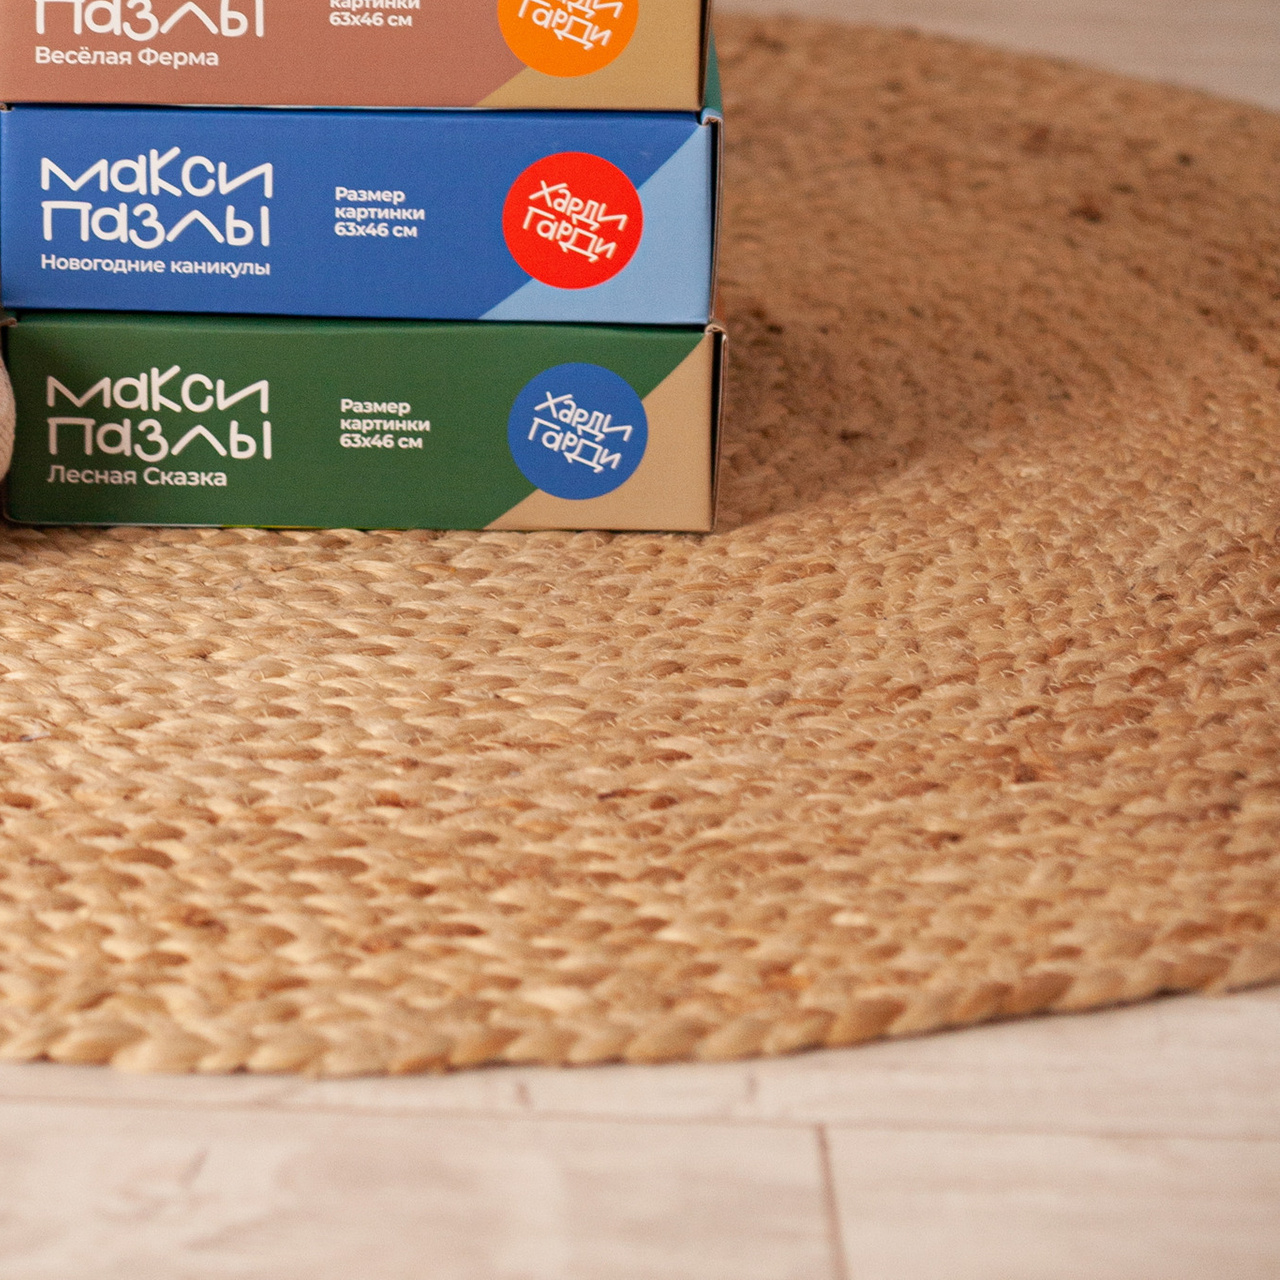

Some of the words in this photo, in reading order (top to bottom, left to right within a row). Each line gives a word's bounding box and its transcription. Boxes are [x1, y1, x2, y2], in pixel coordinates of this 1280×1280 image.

[387, 14, 413, 27] см
[35, 46, 132, 65] Весёлая
[137, 47, 219, 70] Ферма
[335, 186, 406, 206] Размер
[334, 206, 426, 222] картинки
[392, 225, 418, 238] см
[41, 253, 166, 274] Новогодние
[170, 260, 271, 279] каникулы
[340, 398, 411, 417] Размер
[340, 418, 431, 434] картинки
[397, 436, 423, 449] см
[47, 465, 137, 485] Лесная
[143, 467, 227, 487] Сказка
